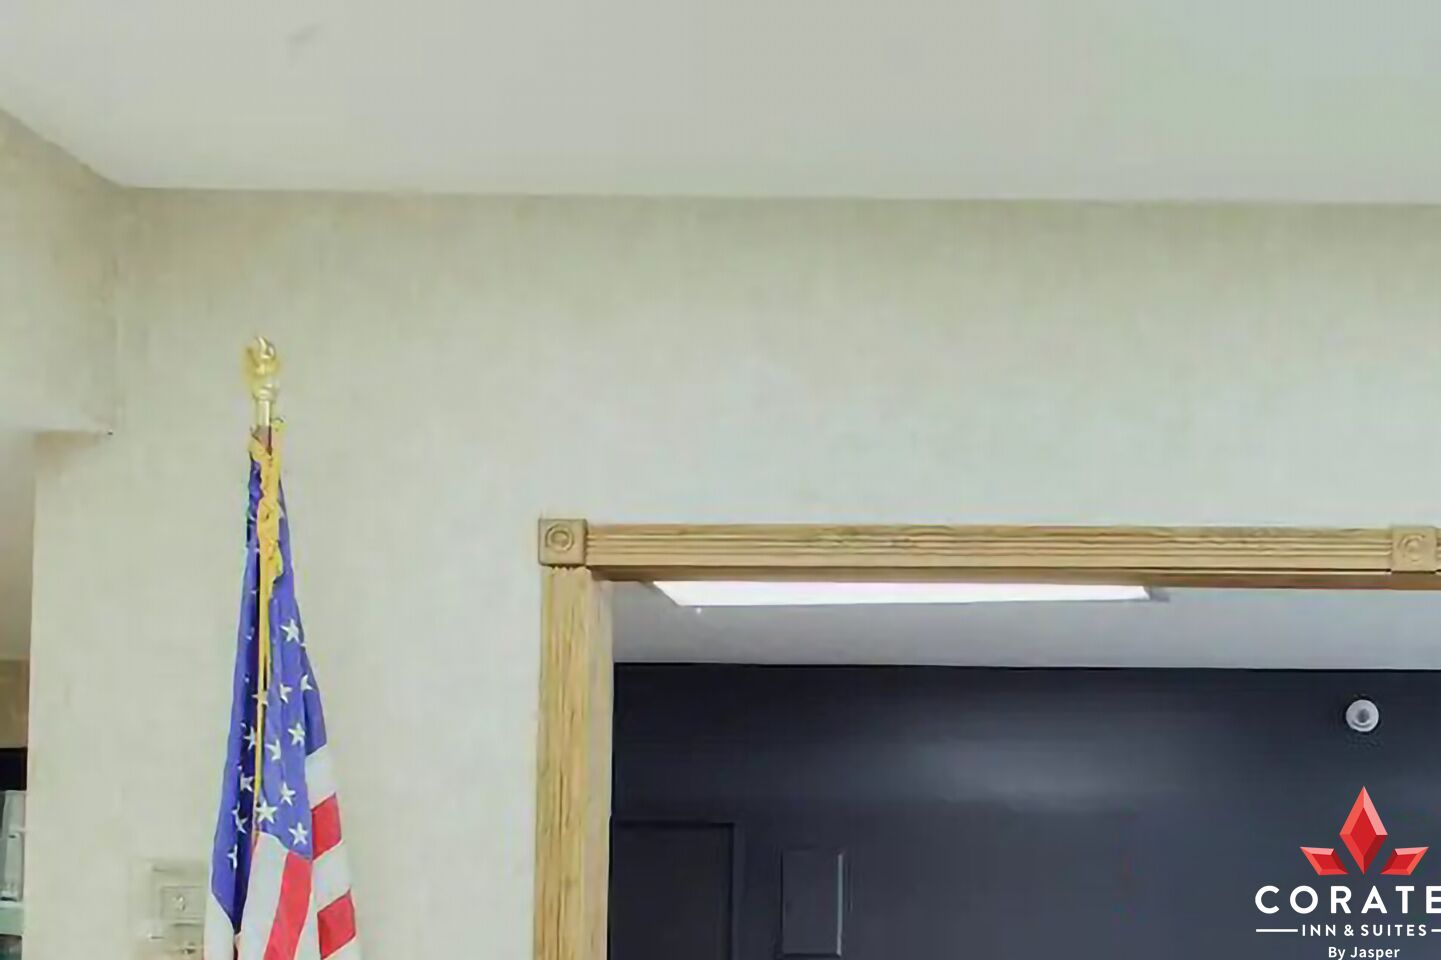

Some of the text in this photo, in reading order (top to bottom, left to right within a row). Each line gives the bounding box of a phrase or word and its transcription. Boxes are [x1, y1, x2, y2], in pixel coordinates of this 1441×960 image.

[1301, 924, 1428, 937] INN & SUITES
[1328, 946, 1401, 960] By Jasper
